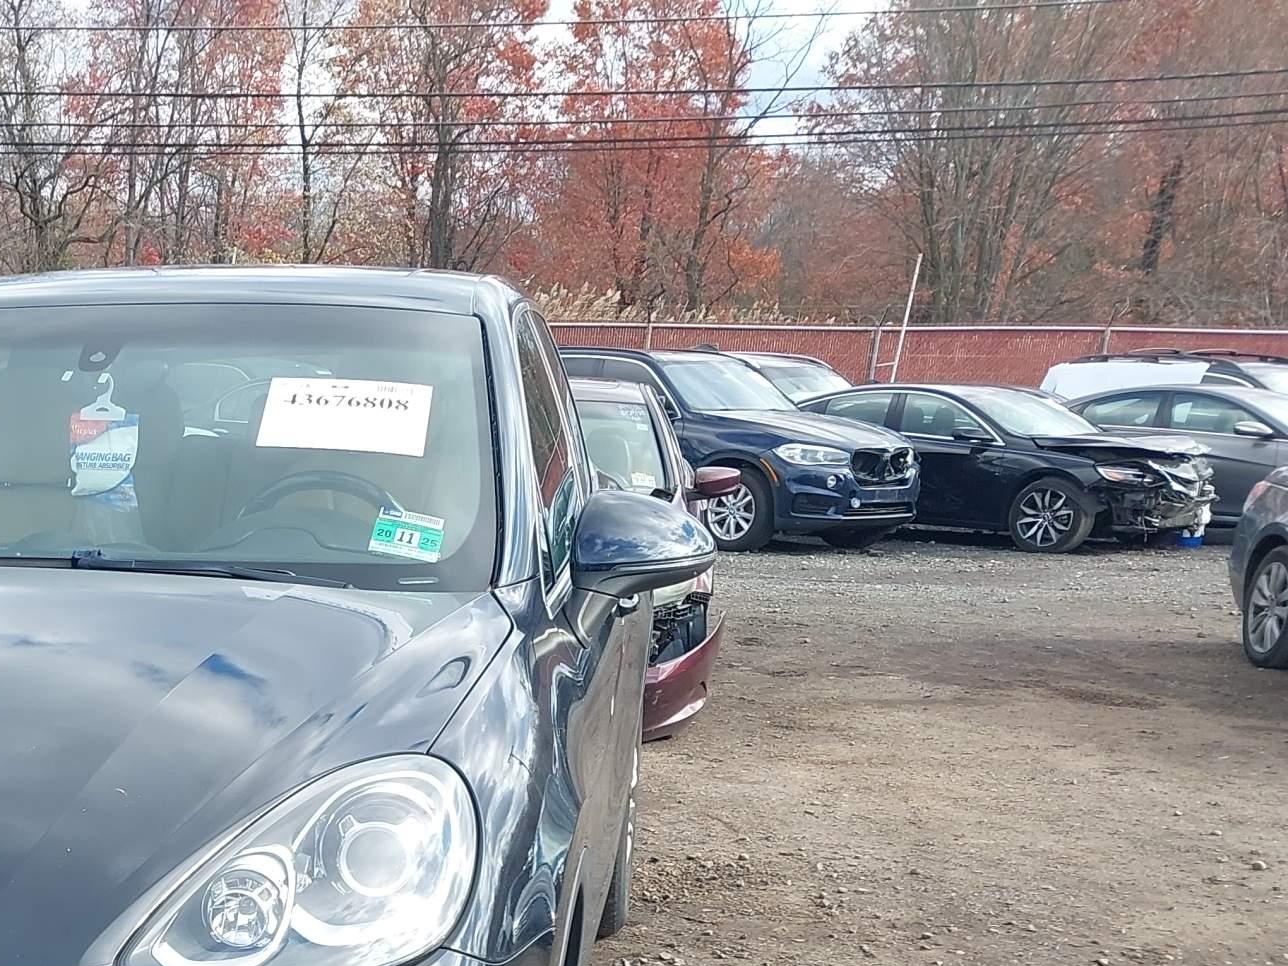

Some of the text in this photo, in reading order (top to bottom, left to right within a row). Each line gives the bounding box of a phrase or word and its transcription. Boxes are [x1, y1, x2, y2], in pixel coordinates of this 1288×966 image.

[283, 393, 410, 411] 43676808
[376, 528, 439, 547] 20 11 25
